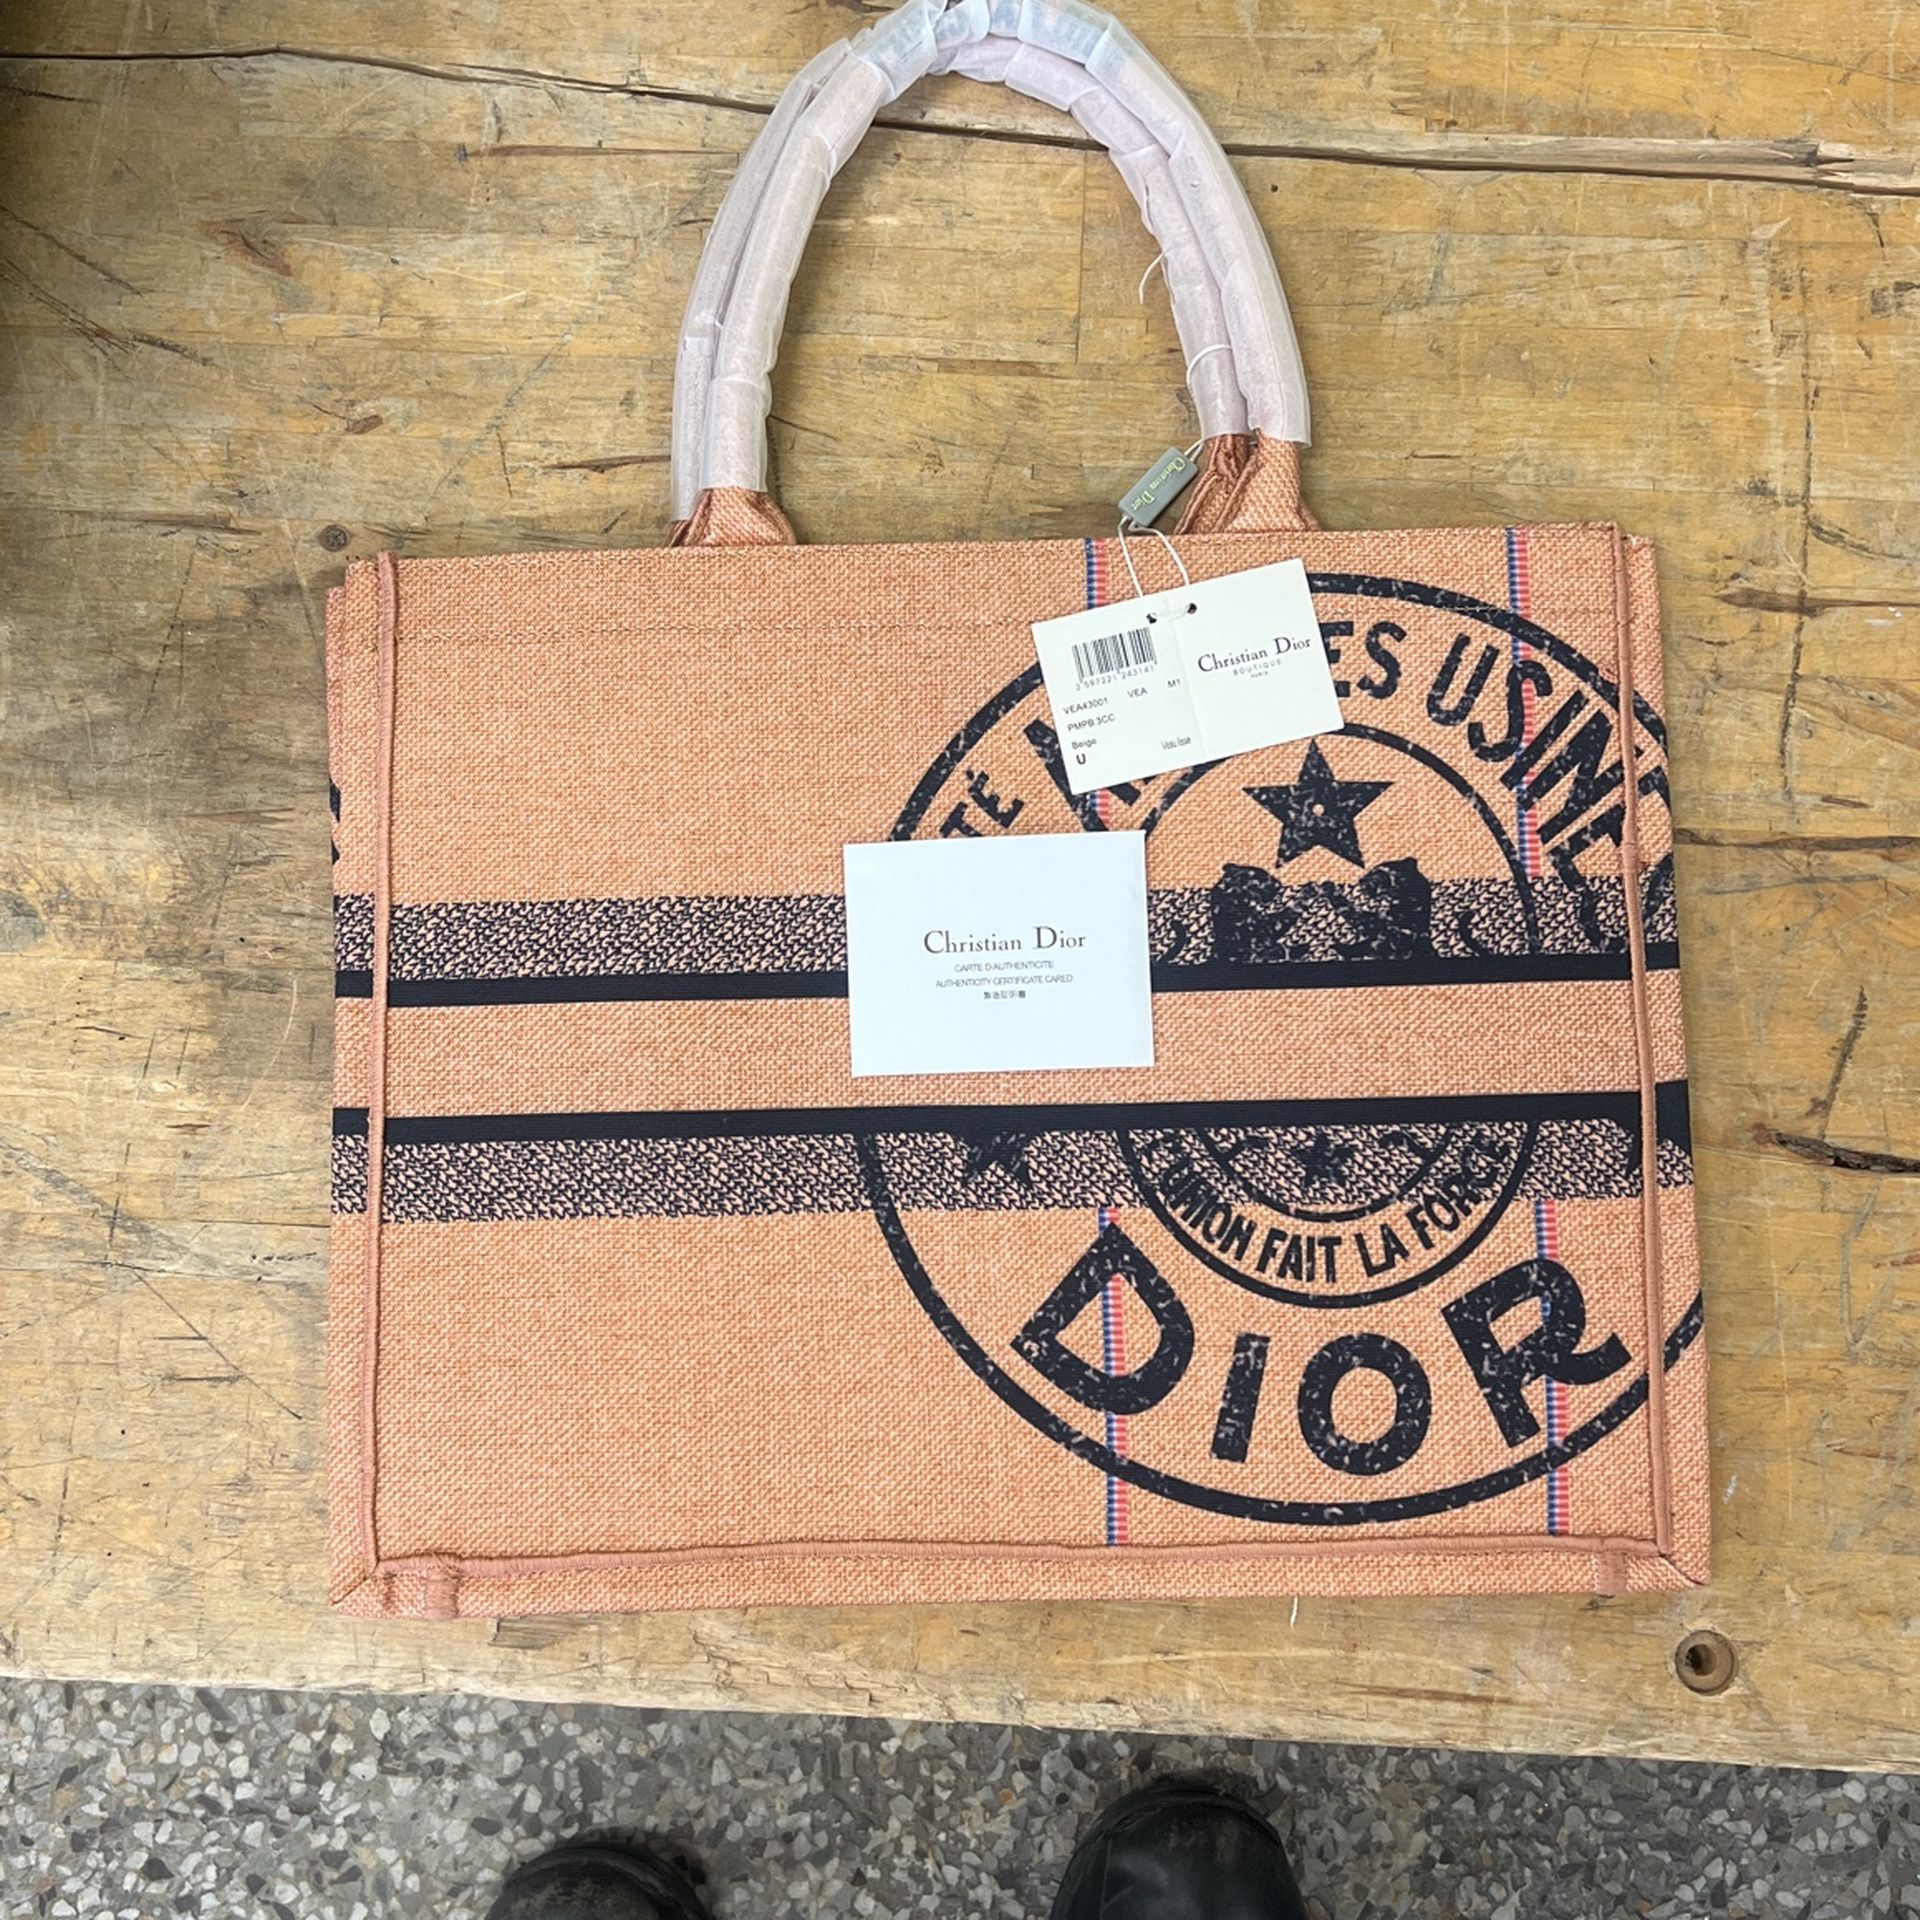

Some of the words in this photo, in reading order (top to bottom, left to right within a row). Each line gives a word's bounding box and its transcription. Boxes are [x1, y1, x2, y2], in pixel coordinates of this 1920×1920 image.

[1131, 490, 1155, 511] Dior
[1197, 647, 1269, 674] Christian
[1273, 635, 1313, 655] Dior
[1233, 658, 1283, 677] BOUTIQUE
[1127, 687, 1148, 699] VEA
[1071, 737, 1098, 750] Beige
[1076, 753, 1087, 765] U
[923, 929, 1022, 954] Christian
[1032, 926, 1087, 950] Dior
[954, 962, 984, 973] CARTE
[935, 976, 992, 988] AUTHENTICITY
[992, 975, 1044, 987] CERTIFICATE
[1255, 1230, 1342, 1283] FAIT
[1355, 1225, 1409, 1276] LA
[1405, 1131, 1510, 1249] FORCE
[1009, 1222, 1634, 1478] DIOR
